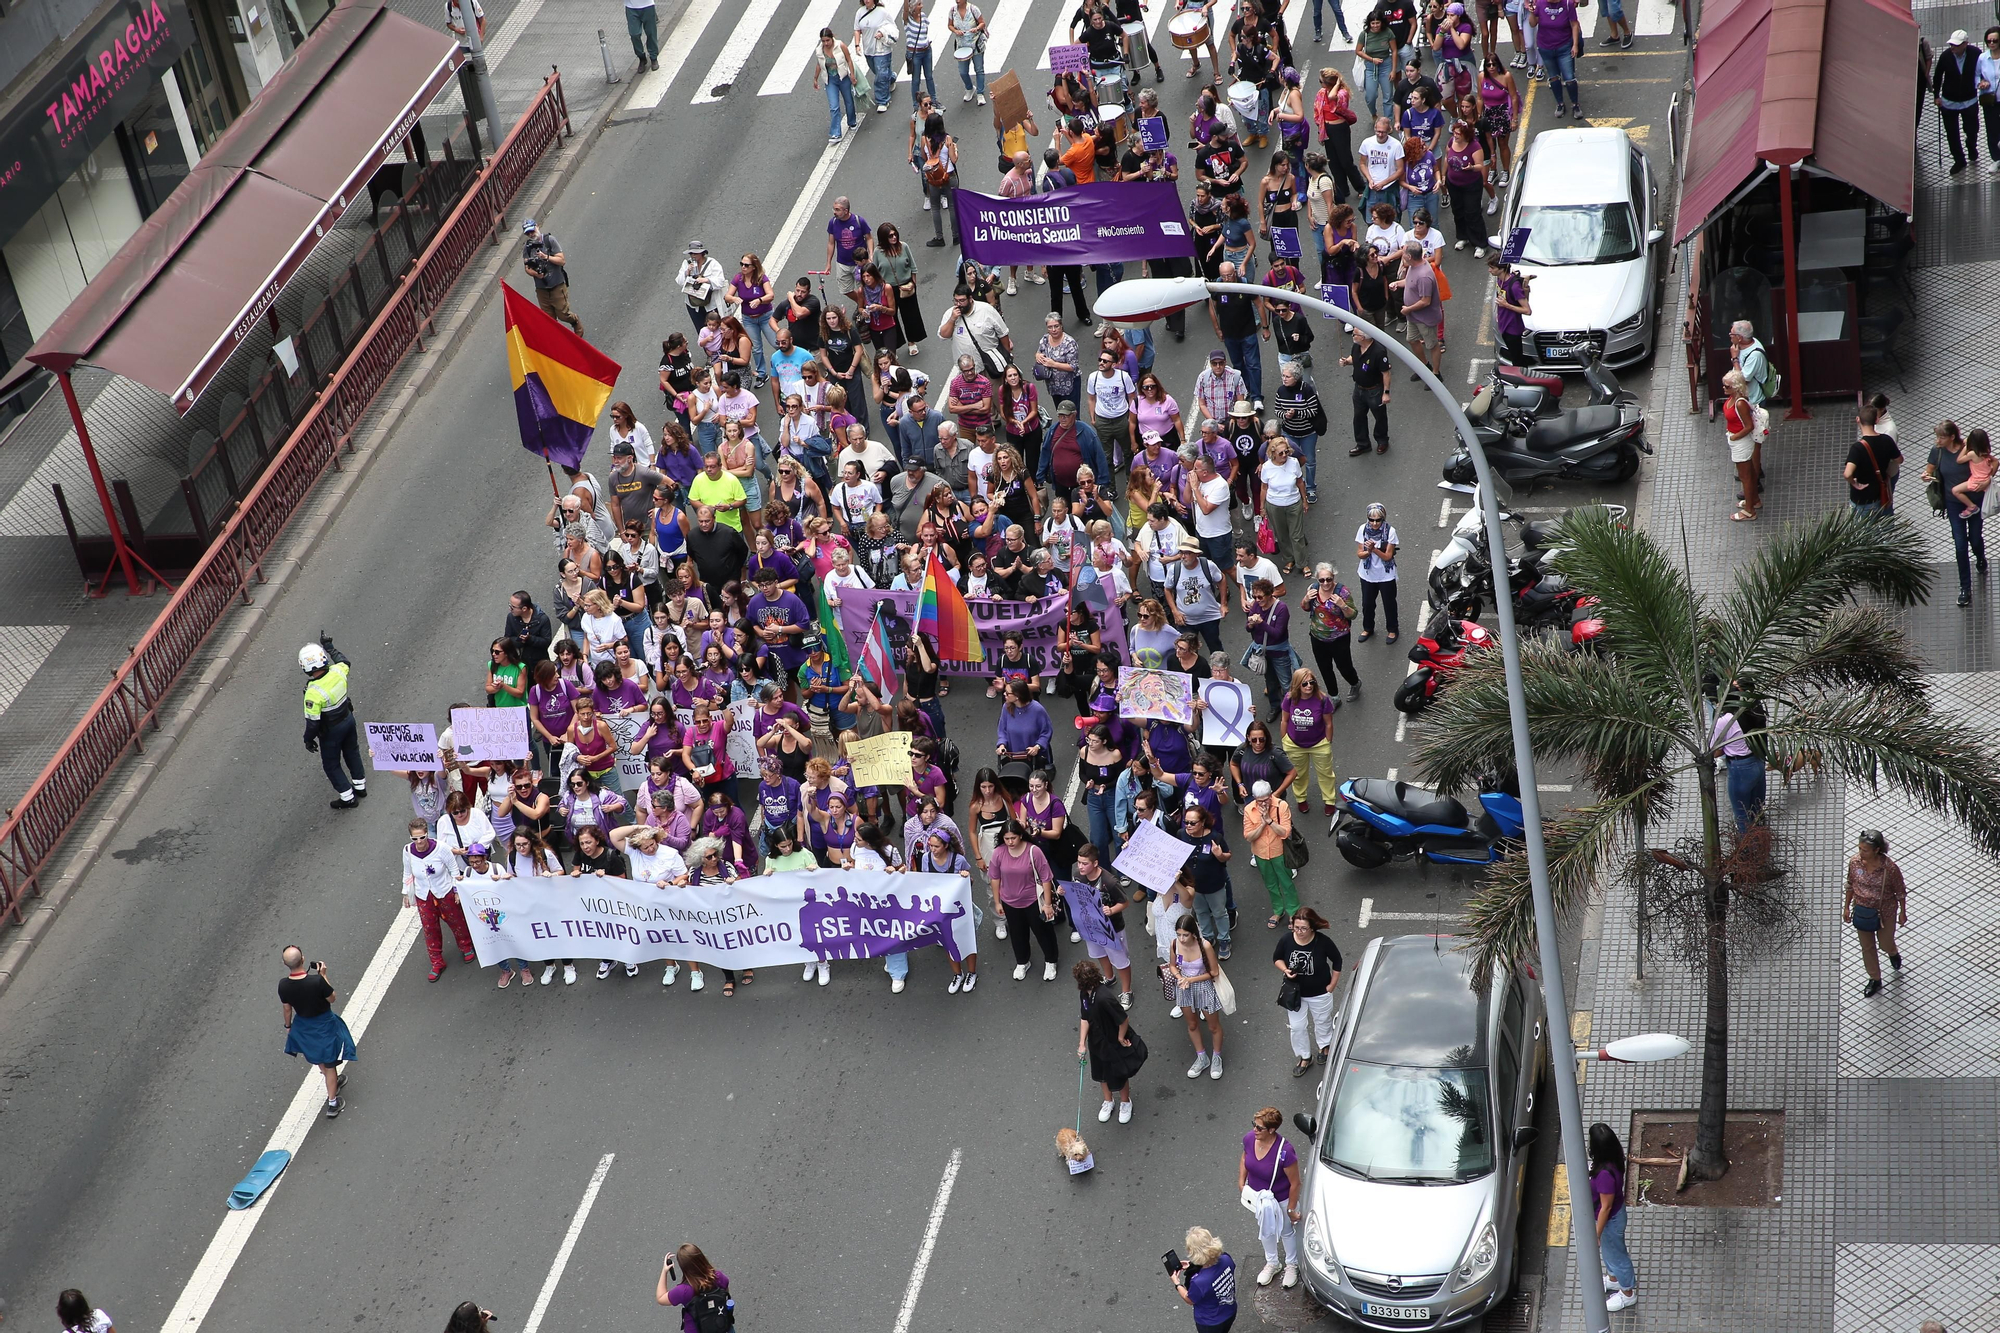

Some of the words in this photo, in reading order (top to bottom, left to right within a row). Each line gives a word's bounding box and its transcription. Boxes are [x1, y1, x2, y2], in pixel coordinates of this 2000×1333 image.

[46, 1, 166, 134] TAMARAGUA
[60, 97, 107, 148] CAFETERÍA
[108, 90, 114, 99] &
[114, 27, 171, 91] RESTAURANTE
[382, 110, 417, 155] TAMARAGUA
[979, 210, 996, 225] NO
[999, 206, 1070, 228] CONSIENTO
[974, 226, 988, 242] La
[988, 226, 1042, 245] Violencia
[1043, 223, 1081, 244] Sexual
[1097, 225, 1145, 238] #NoConsiento
[233, 280, 280, 341] RESTAURANTE
[475, 707, 518, 720] FALDA
[735, 704, 744, 715] Y
[368, 724, 411, 735] EDUQUEMOS
[454, 720, 468, 733] NO
[470, 720, 485, 733] ES
[487, 719, 525, 733] CORTA
[382, 734, 394, 742] NO
[395, 733, 425, 743] VIOLAR
[456, 733, 469, 745] TU
[849, 742, 867, 755] LA
[390, 749, 435, 763] VIOLACIÓN
[622, 763, 643, 775] QUE
[871, 764, 880, 781] O
[474, 897, 501, 906] RED
[580, 897, 666, 922] VIOLENCIA
[668, 902, 764, 925] MACHISTA.
[531, 921, 558, 940] EL
[561, 920, 641, 946] TIEMPO
[646, 928, 689, 945] DEL
[692, 922, 792, 950] SILENCIO
[814, 917, 853, 943] ¡SE
[859, 917, 942, 942] ACABÓ!
[1370, 1305, 1400, 1317] 9339
[1404, 1308, 1427, 1318] GTS
